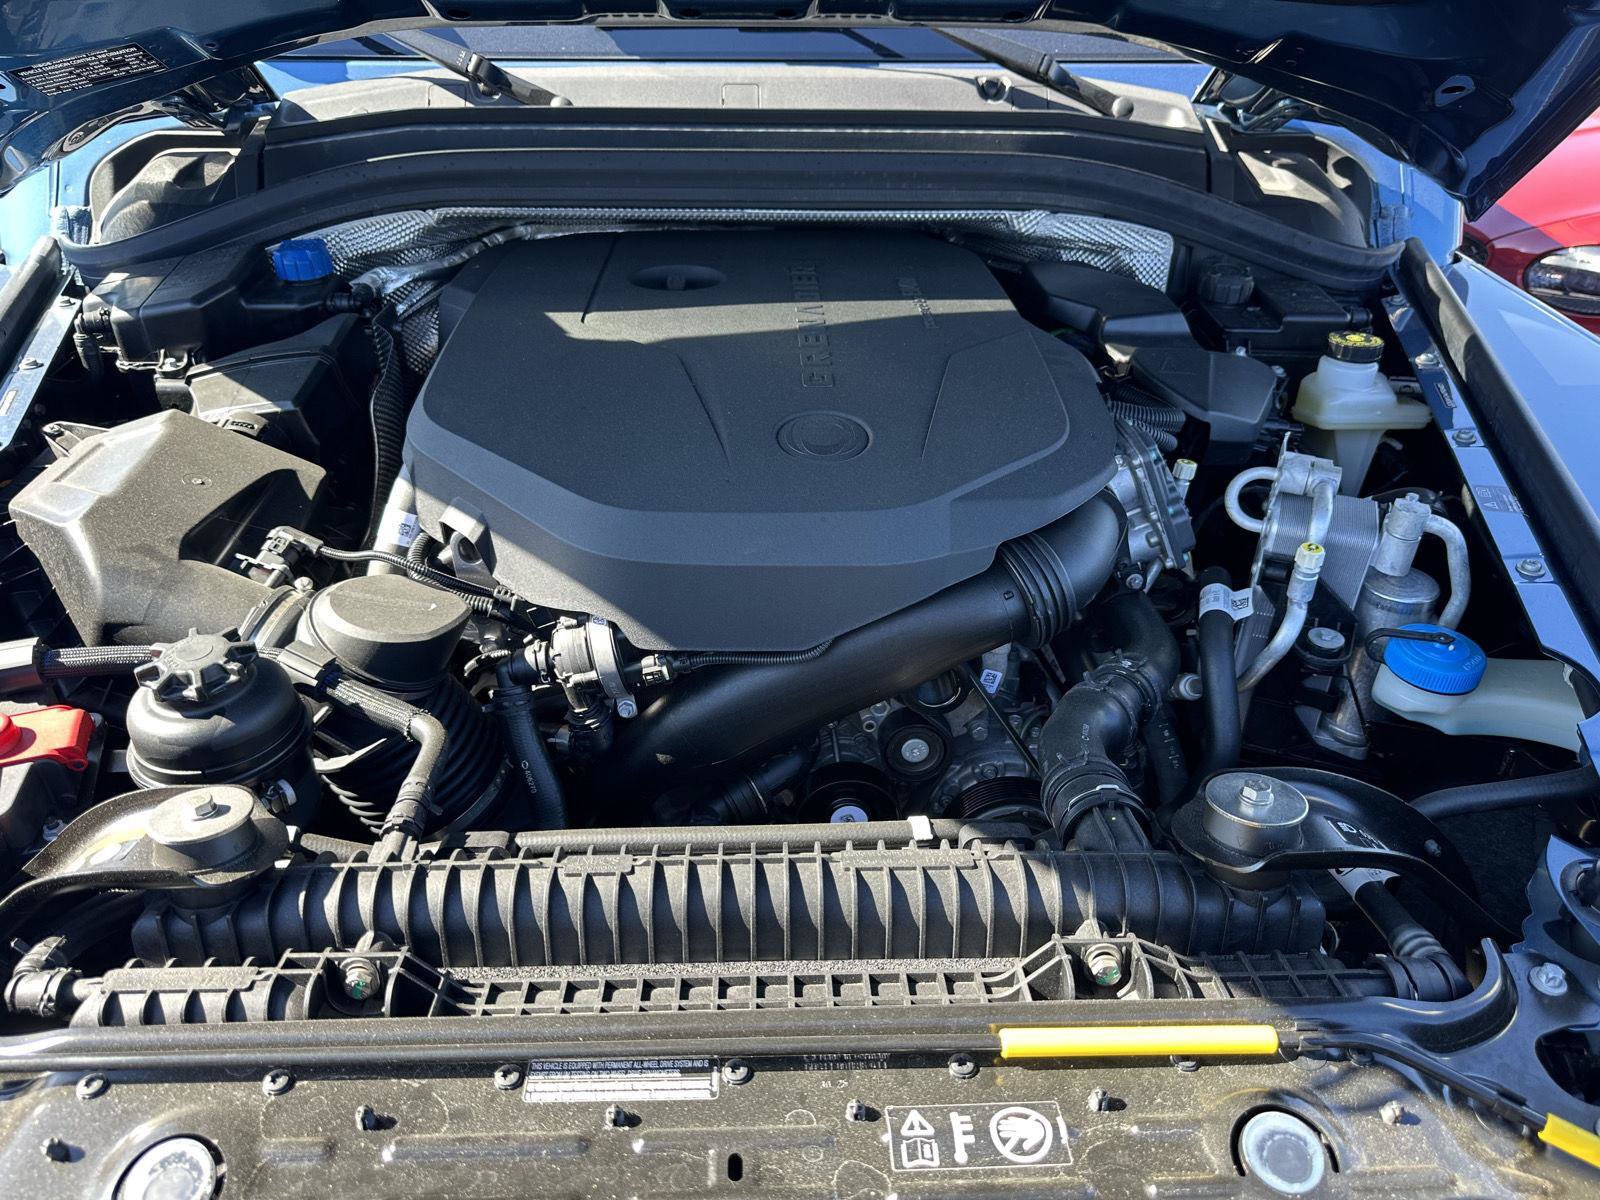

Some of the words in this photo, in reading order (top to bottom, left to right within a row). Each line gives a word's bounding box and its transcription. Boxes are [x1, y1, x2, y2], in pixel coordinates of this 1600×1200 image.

[17, 68, 44, 76] VEHICLE
[41, 62, 71, 71] EMISSION
[68, 56, 97, 65] CONTROL
[96, 47, 136, 58] INFORMATION
[532, 1062, 543, 1070] THIS
[543, 1062, 562, 1070] VEHICLE
[568, 1062, 592, 1070] EQUIPPED
[592, 1061, 604, 1069] WITH
[605, 1061, 633, 1069] PERMANENT
[633, 1060, 659, 1068] ALL-WHEEL
[660, 1060, 674, 1068] DRIVE
[675, 1060, 693, 1068] SYSTEM
[703, 1059, 709, 1067] IS
[549, 1071, 560, 1079] FROM
